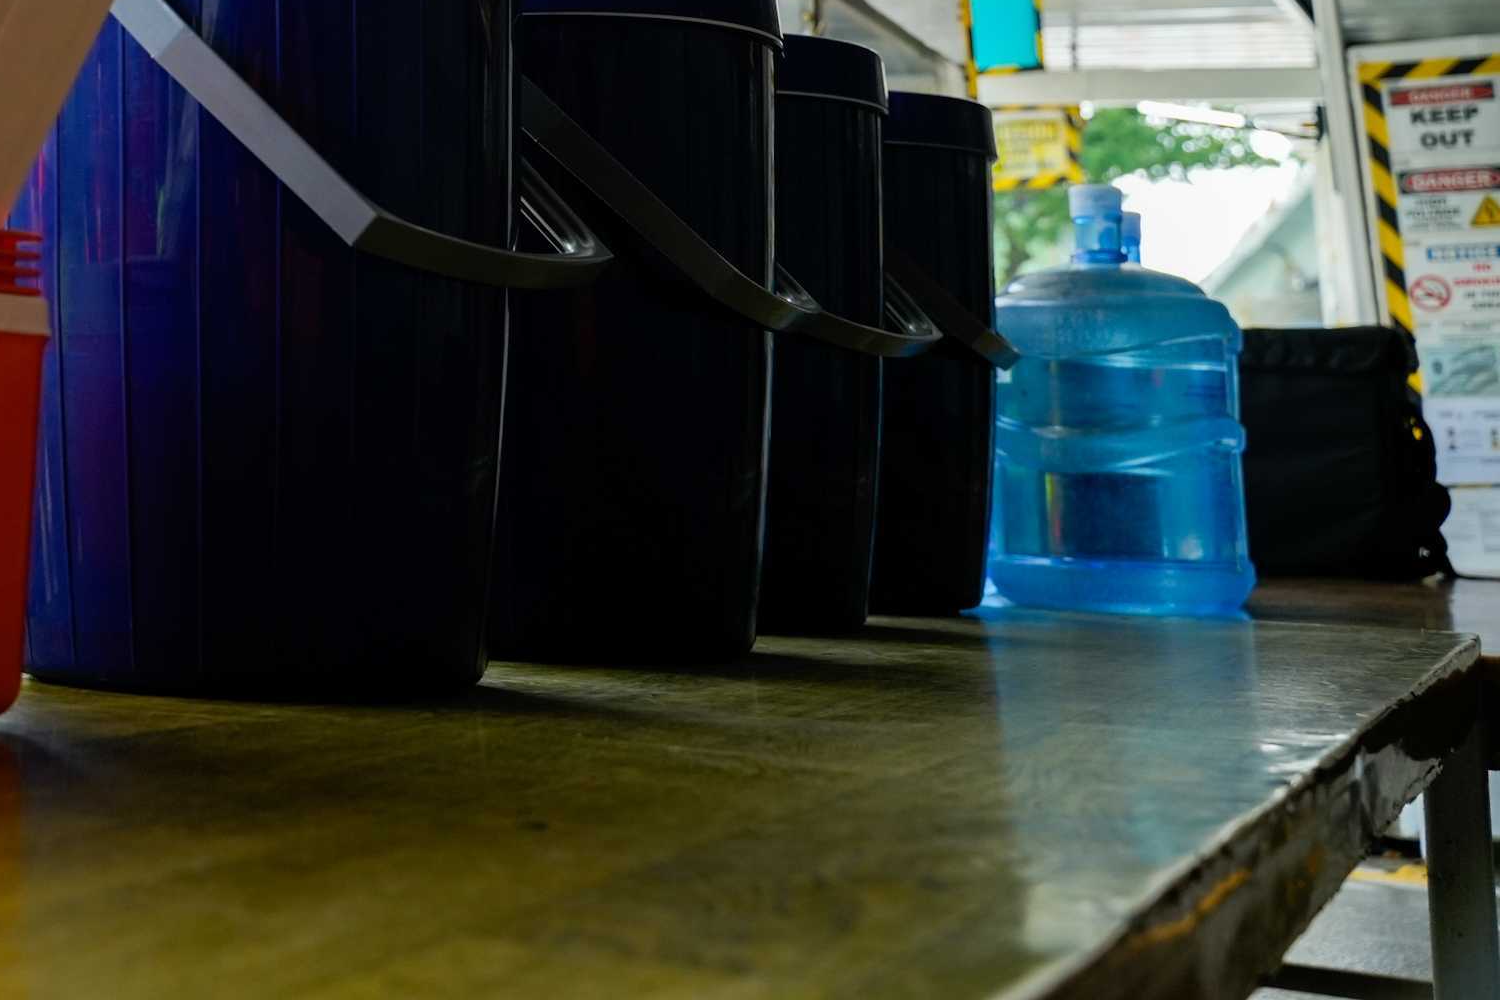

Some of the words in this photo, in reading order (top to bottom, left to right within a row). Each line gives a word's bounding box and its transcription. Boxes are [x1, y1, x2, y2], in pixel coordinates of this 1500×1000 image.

[1409, 106, 1479, 125] KEEP
[1419, 129, 1475, 150] OUT
[1411, 170, 1491, 191] DANGER
